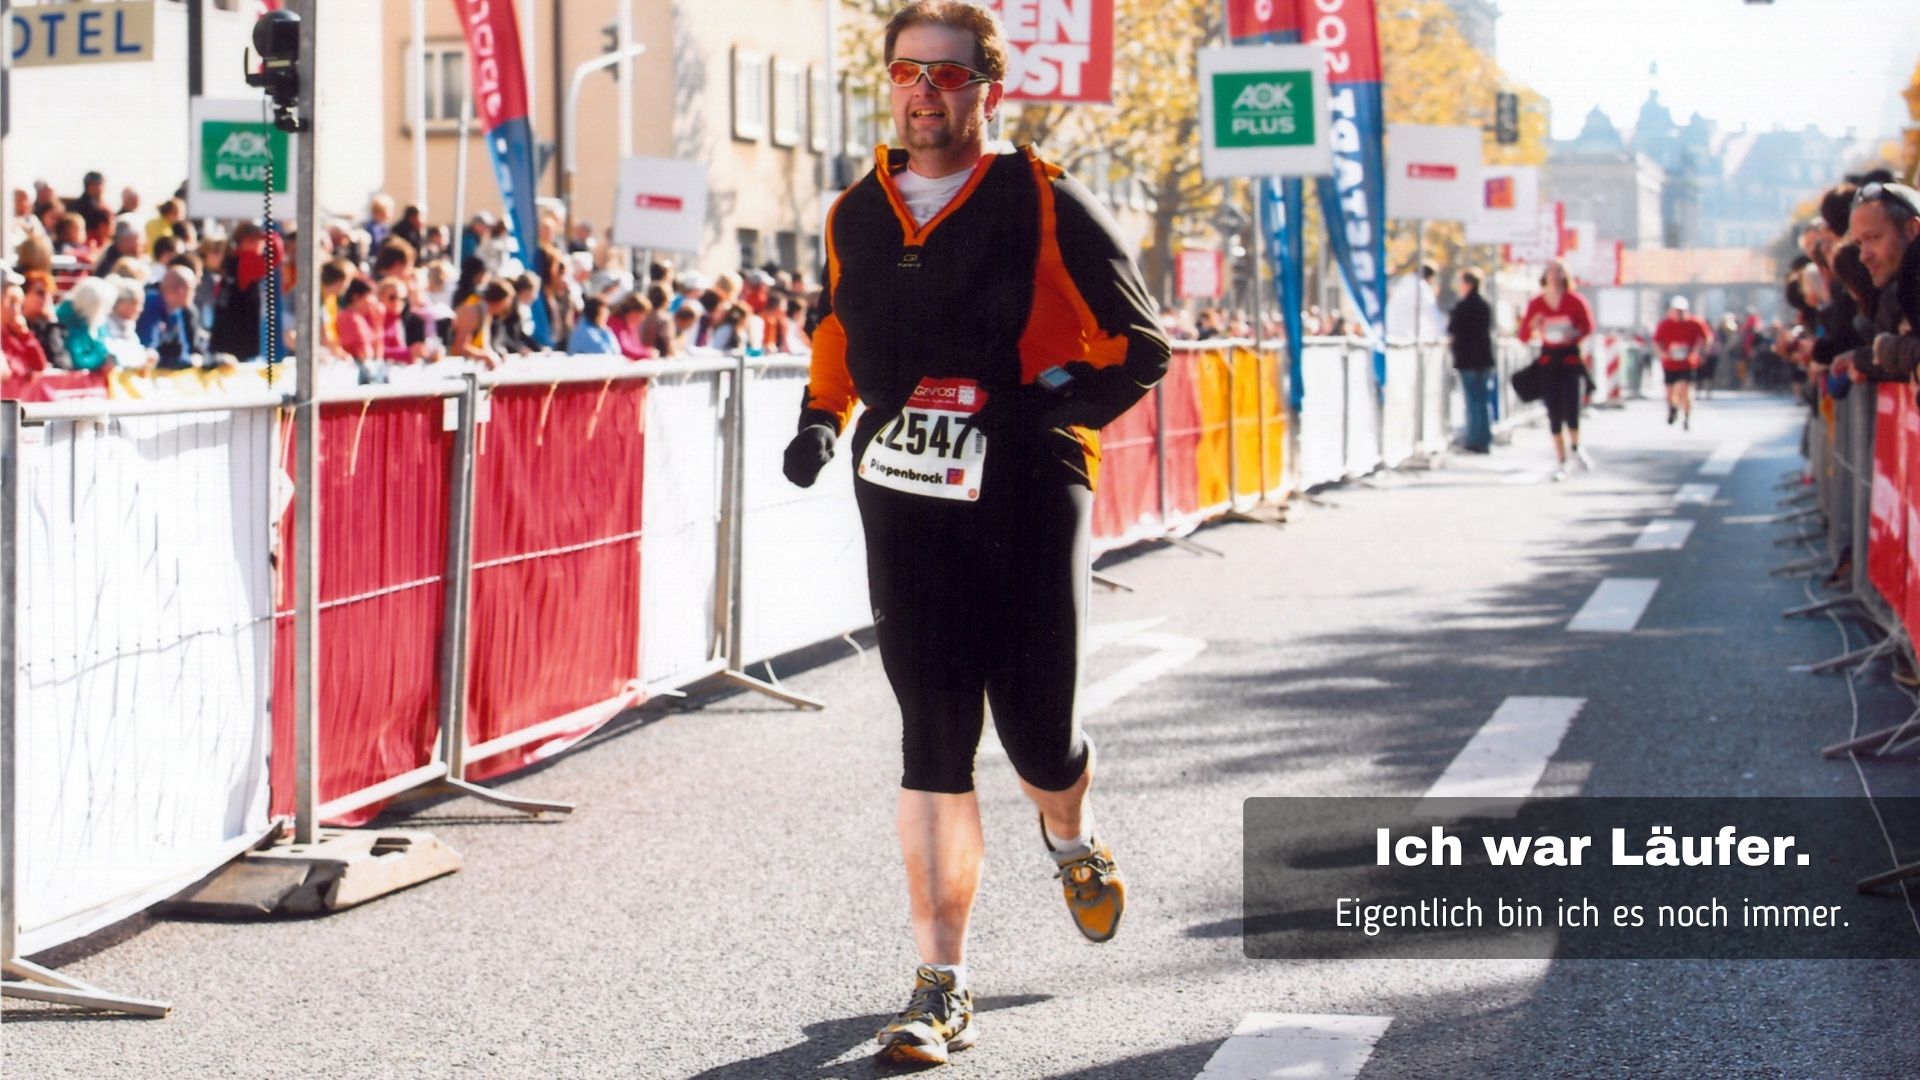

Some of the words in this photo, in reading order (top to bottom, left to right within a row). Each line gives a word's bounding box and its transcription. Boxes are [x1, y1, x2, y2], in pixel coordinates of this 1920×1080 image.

[1231, 82, 1294, 110] AOK
[1231, 117, 1295, 134] PLUS
[216, 131, 273, 159] AOK
[870, 458, 943, 484] Piepenbrock
